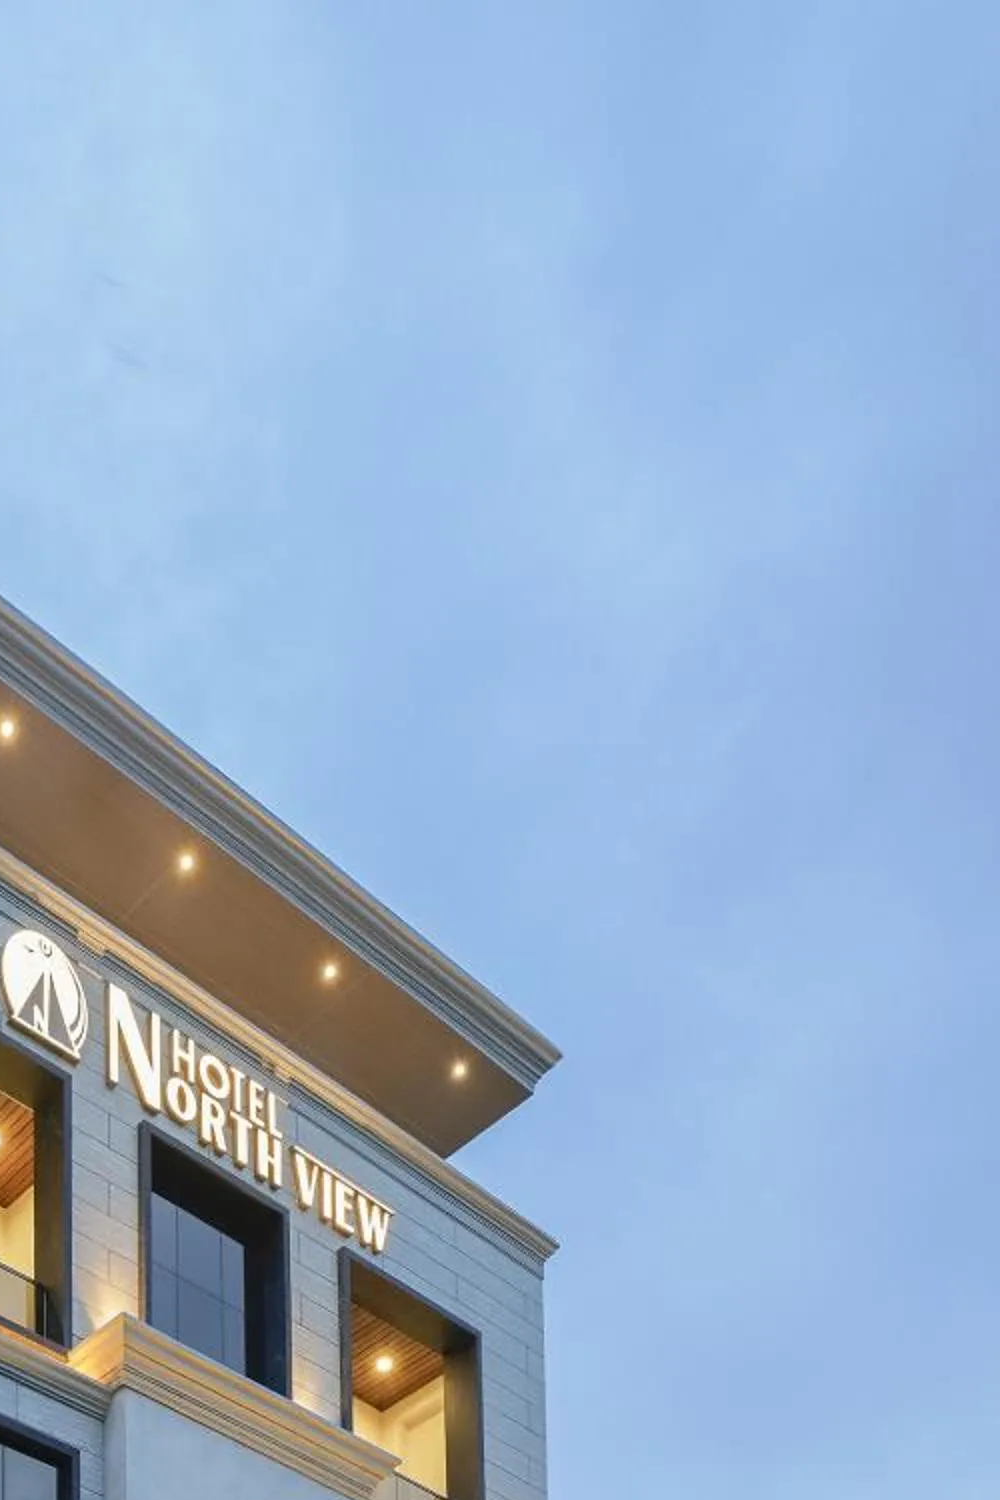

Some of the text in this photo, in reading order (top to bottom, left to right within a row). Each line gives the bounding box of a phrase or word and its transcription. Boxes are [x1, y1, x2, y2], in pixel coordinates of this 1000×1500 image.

[105, 982, 393, 1254] NORTH VIEW
[172, 1029, 283, 1138] HOTEL
